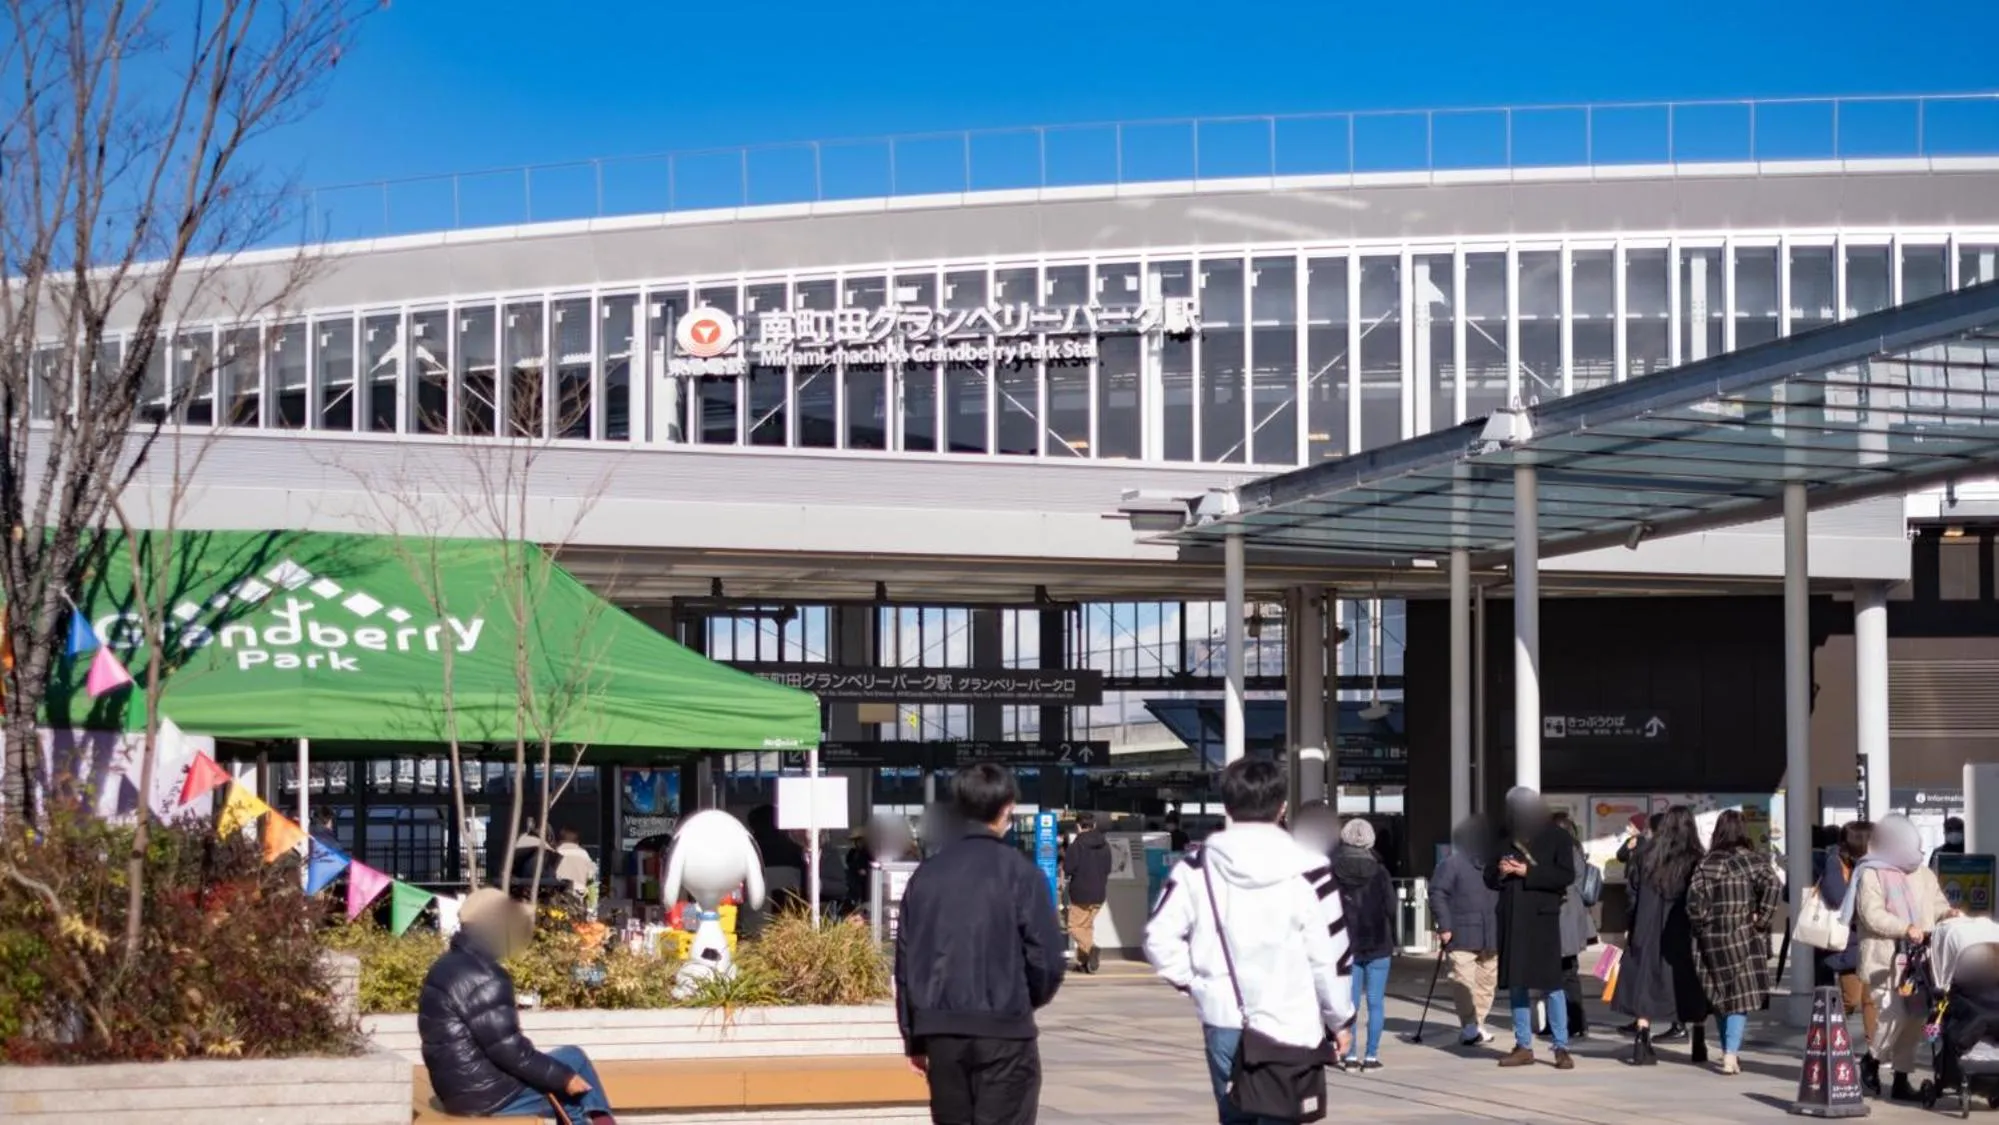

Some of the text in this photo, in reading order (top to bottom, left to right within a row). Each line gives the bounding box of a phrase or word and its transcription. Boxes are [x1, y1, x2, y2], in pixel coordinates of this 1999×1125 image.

[759, 297, 1201, 347] 南町田グランベリーパーク駅
[760, 346, 908, 367] Minami-machida
[914, 342, 1019, 364] Grandberry
[1020, 341, 1061, 360] Park
[237, 650, 361, 671] Park
[1060, 743, 1073, 761] 2
